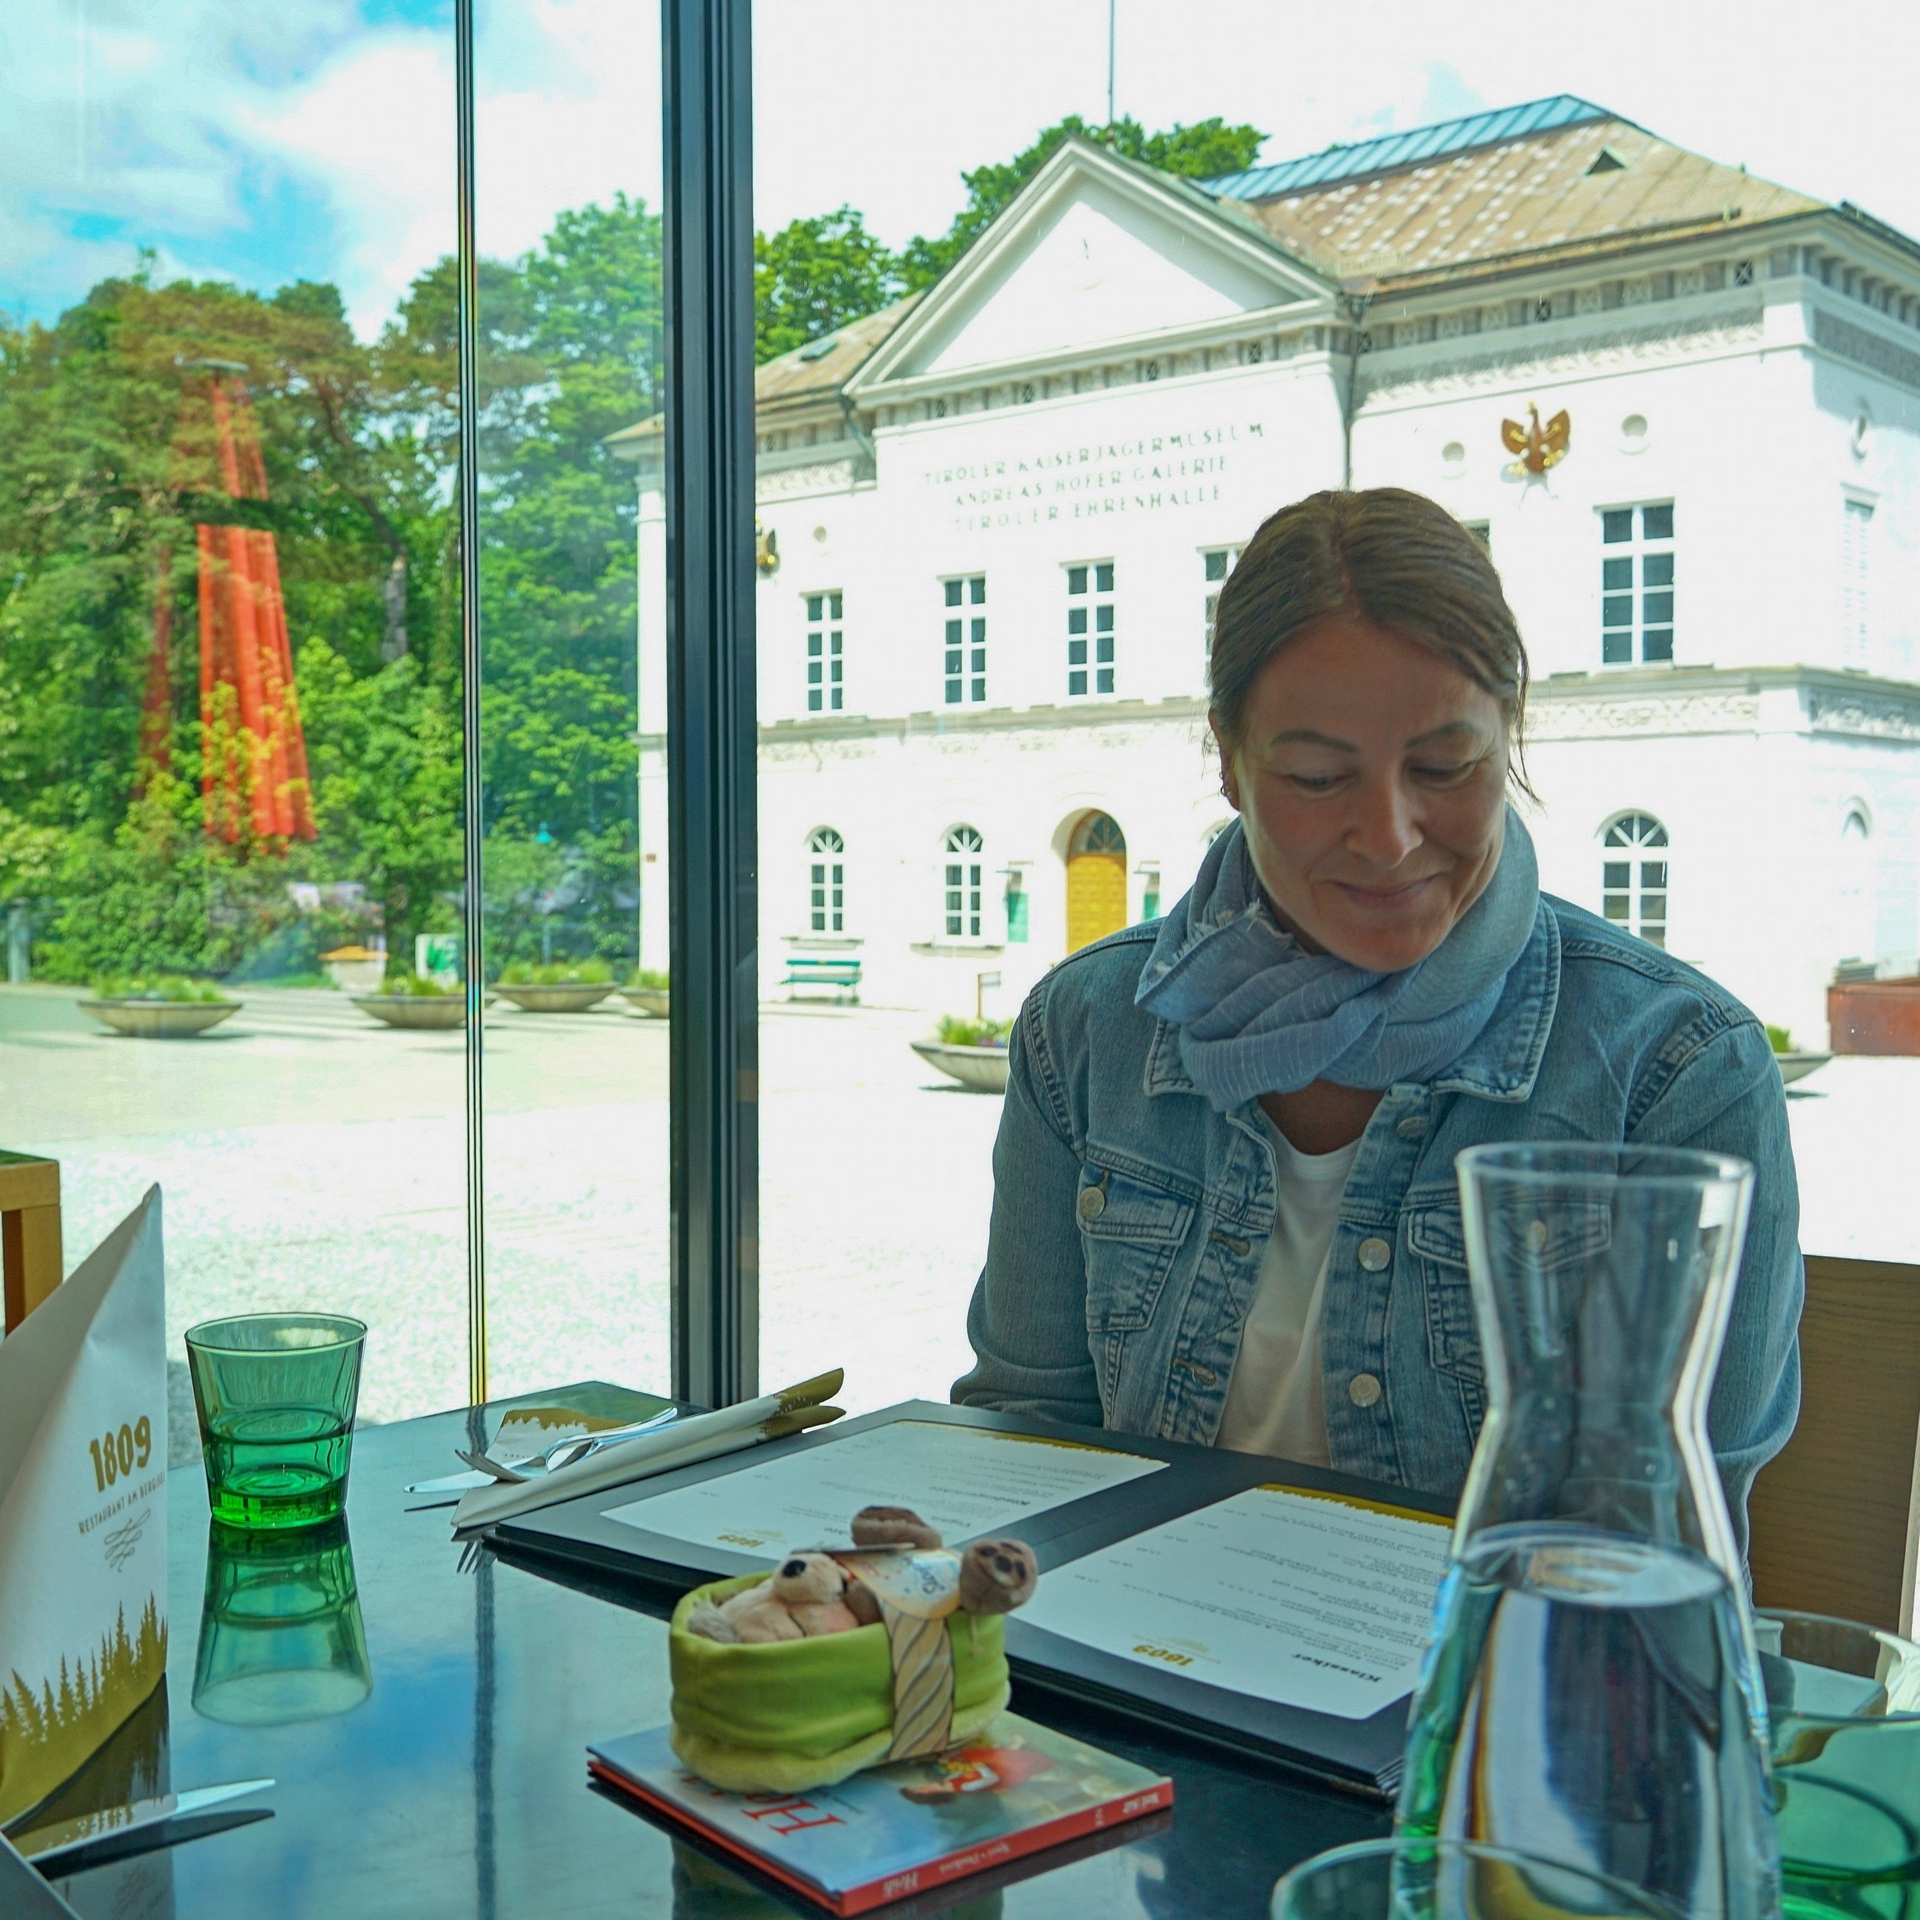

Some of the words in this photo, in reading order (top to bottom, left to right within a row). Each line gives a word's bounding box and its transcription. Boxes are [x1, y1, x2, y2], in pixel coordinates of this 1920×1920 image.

[924, 461, 1005, 485] TIROLER
[956, 483, 1043, 506] ANDREAS
[1056, 470, 1122, 493] HOFER
[1134, 455, 1226, 481] GALERIE
[955, 506, 1058, 531] TIROLER
[1074, 485, 1220, 518] EHRENHALLE
[89, 1415, 151, 1493] 1809
[78, 1497, 125, 1535] RESTAURANT
[127, 1492, 138, 1506] AM
[1132, 1645, 1195, 1667] 1809
[1291, 1653, 1383, 1683] Klassiker
